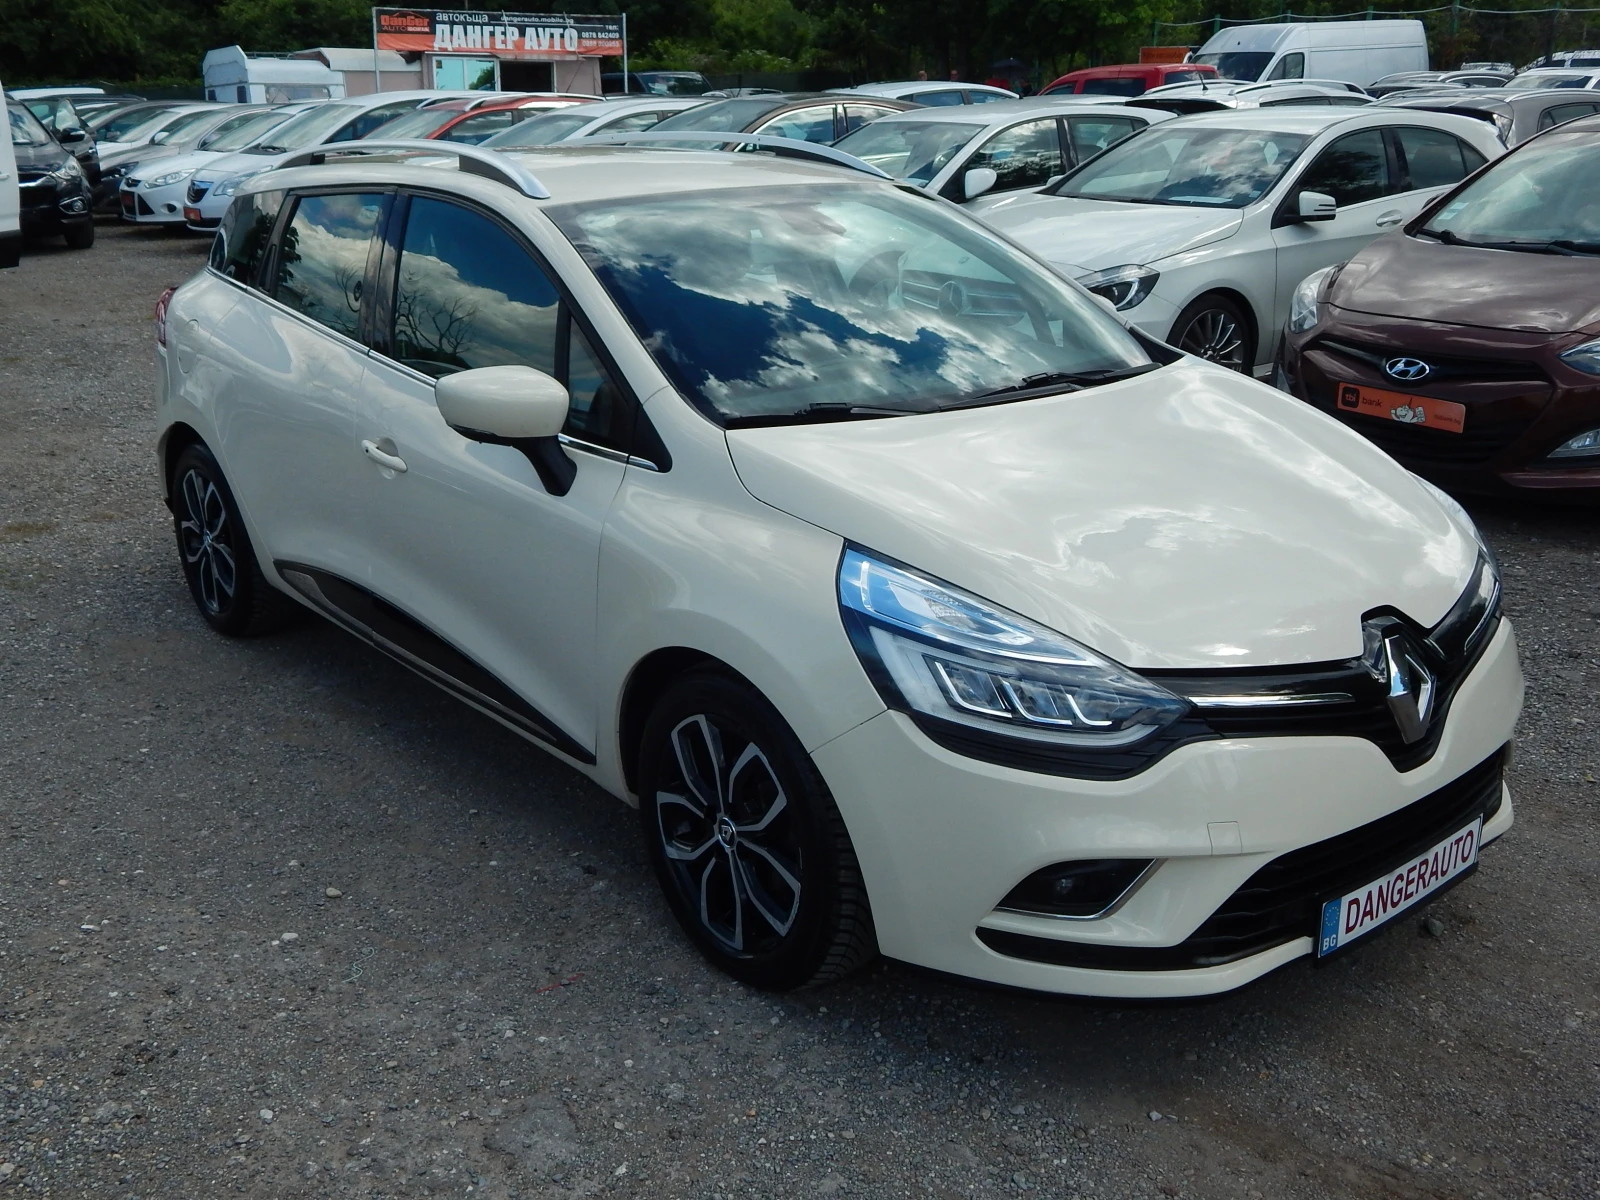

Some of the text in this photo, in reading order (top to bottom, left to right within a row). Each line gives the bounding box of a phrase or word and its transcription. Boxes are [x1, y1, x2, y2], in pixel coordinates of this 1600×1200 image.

[436, 12, 489, 23] автокъща
[434, 24, 578, 51] ДАНГЕР АУТО
[1361, 395, 1383, 408] bank
[1345, 829, 1474, 935] DANGERAUTO
[1322, 934, 1337, 951] BG
